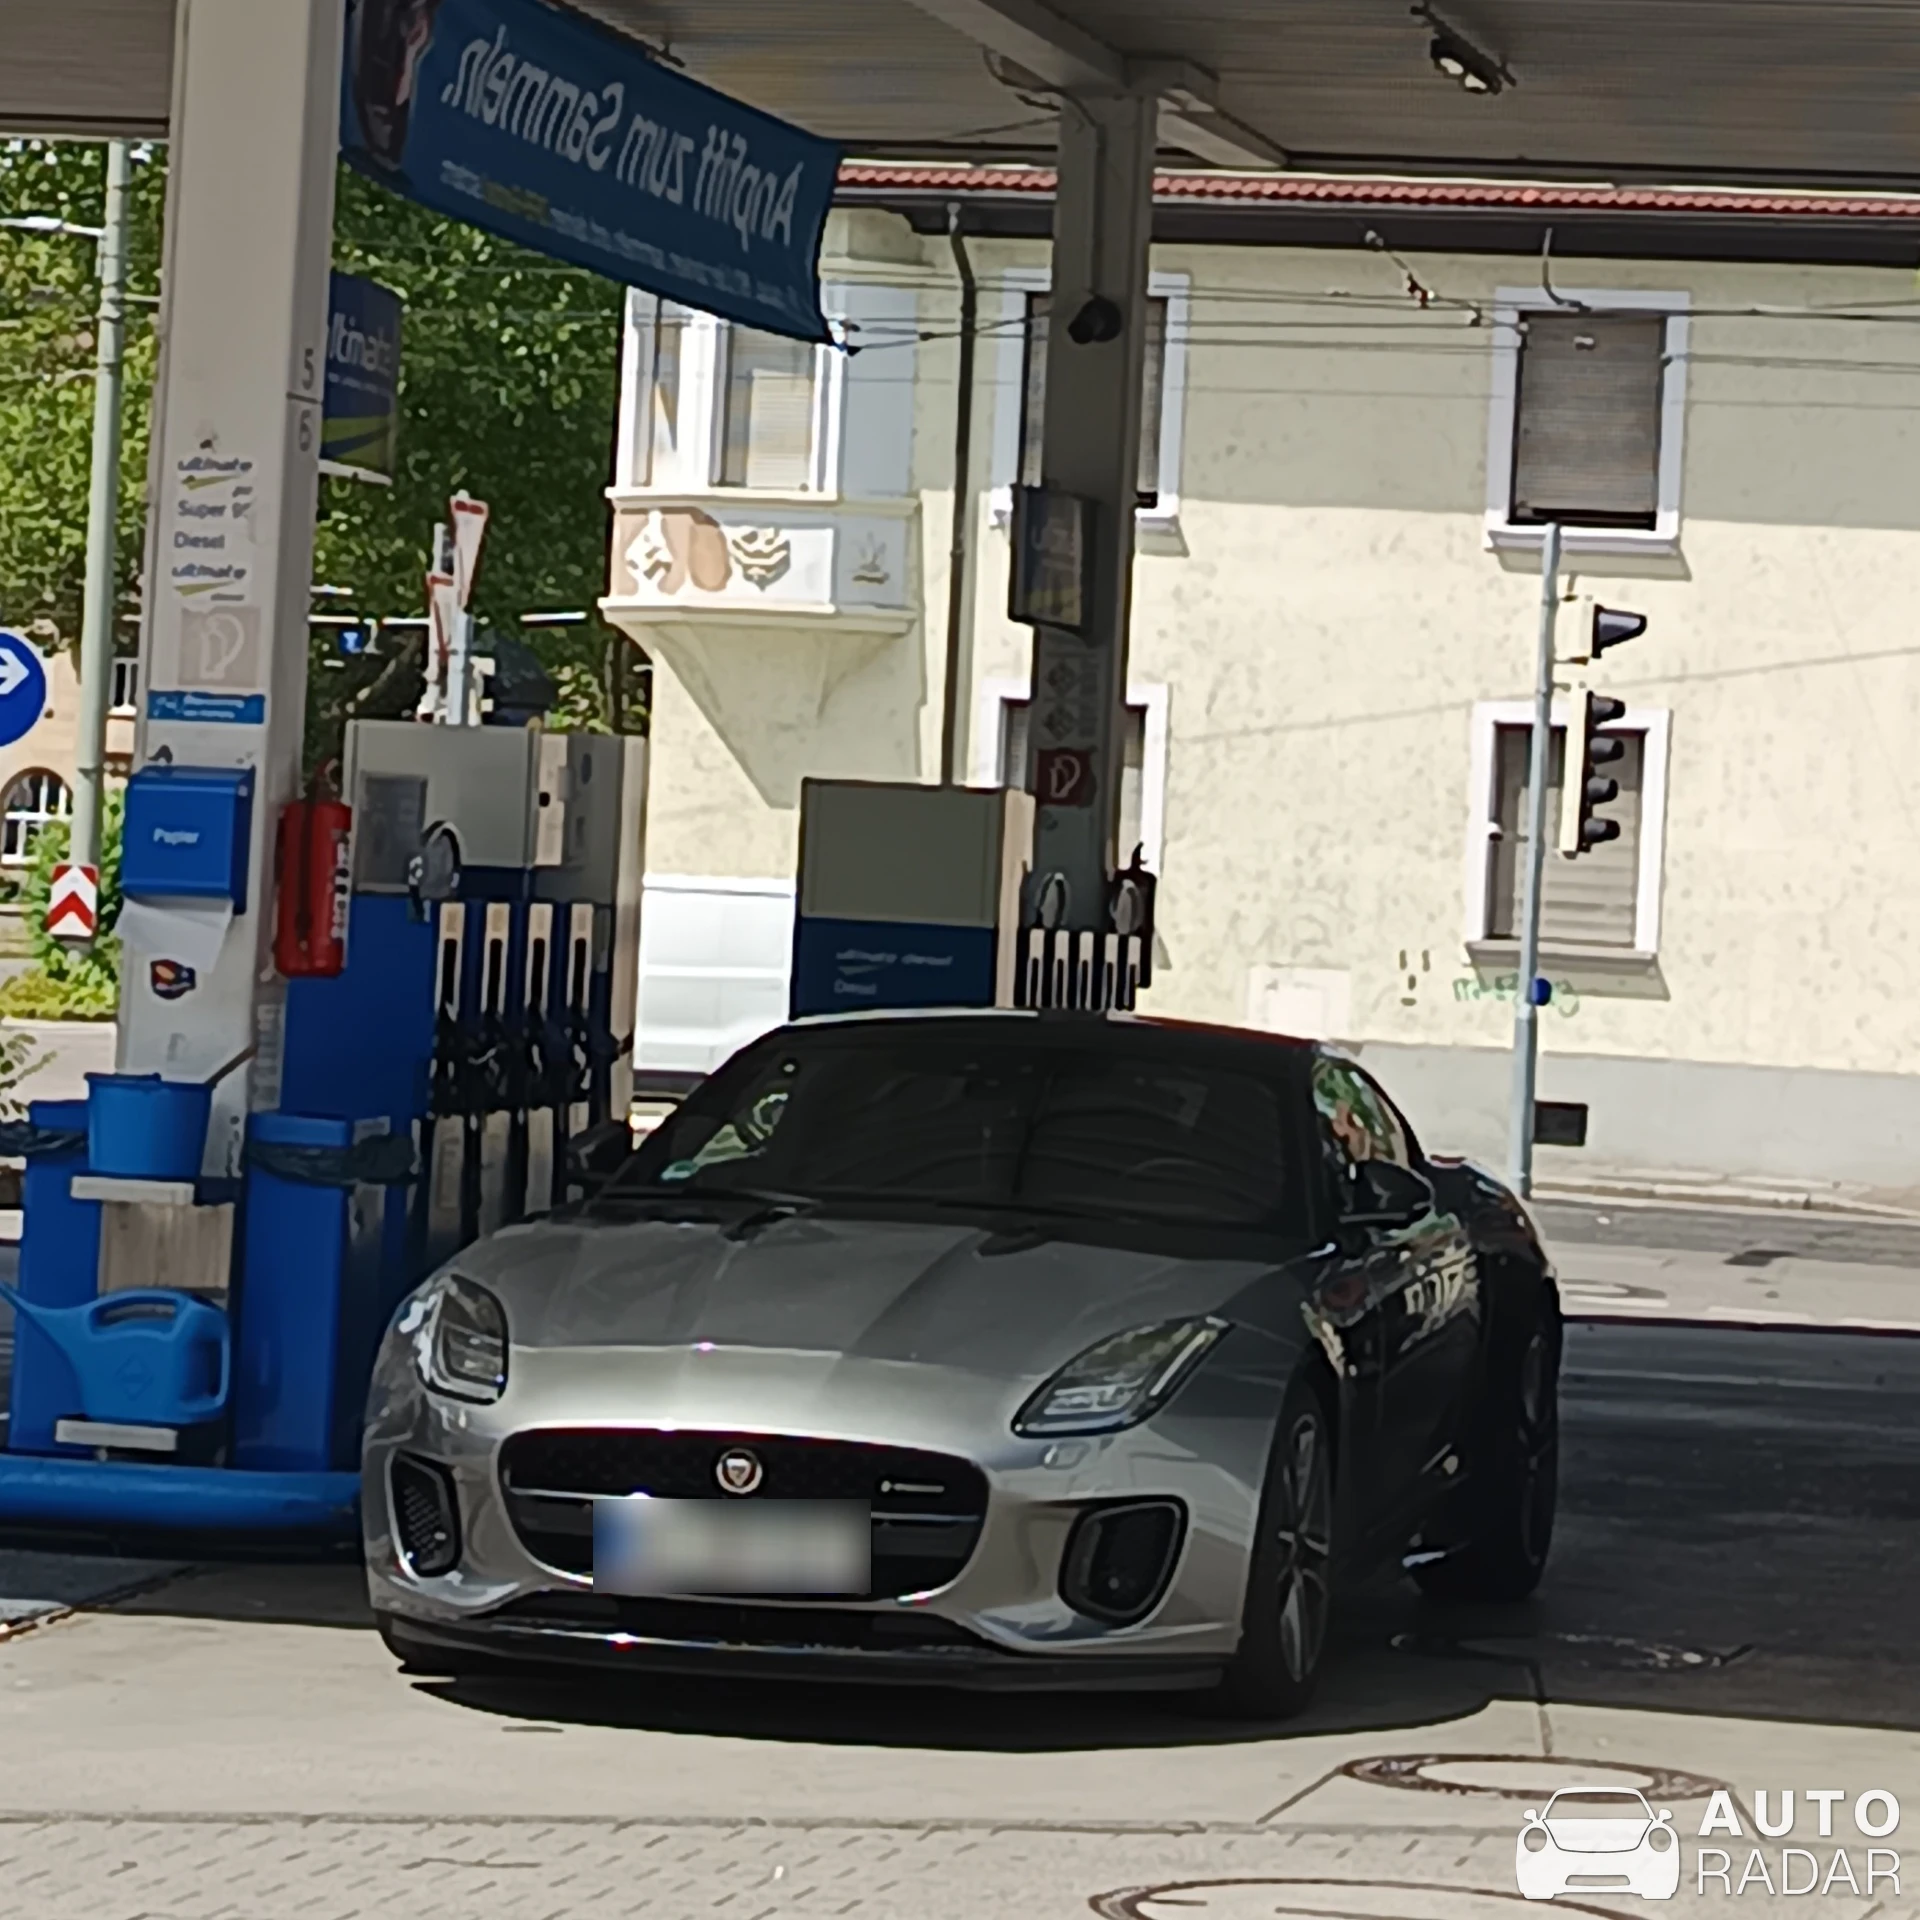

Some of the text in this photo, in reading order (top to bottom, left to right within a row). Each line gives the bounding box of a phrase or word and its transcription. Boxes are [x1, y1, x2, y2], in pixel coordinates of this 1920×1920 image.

[302, 347, 315, 390] 5
[298, 409, 312, 452] 6
[178, 500, 227, 519] Super
[174, 531, 225, 549] Diesel
[153, 827, 199, 846] Papier
